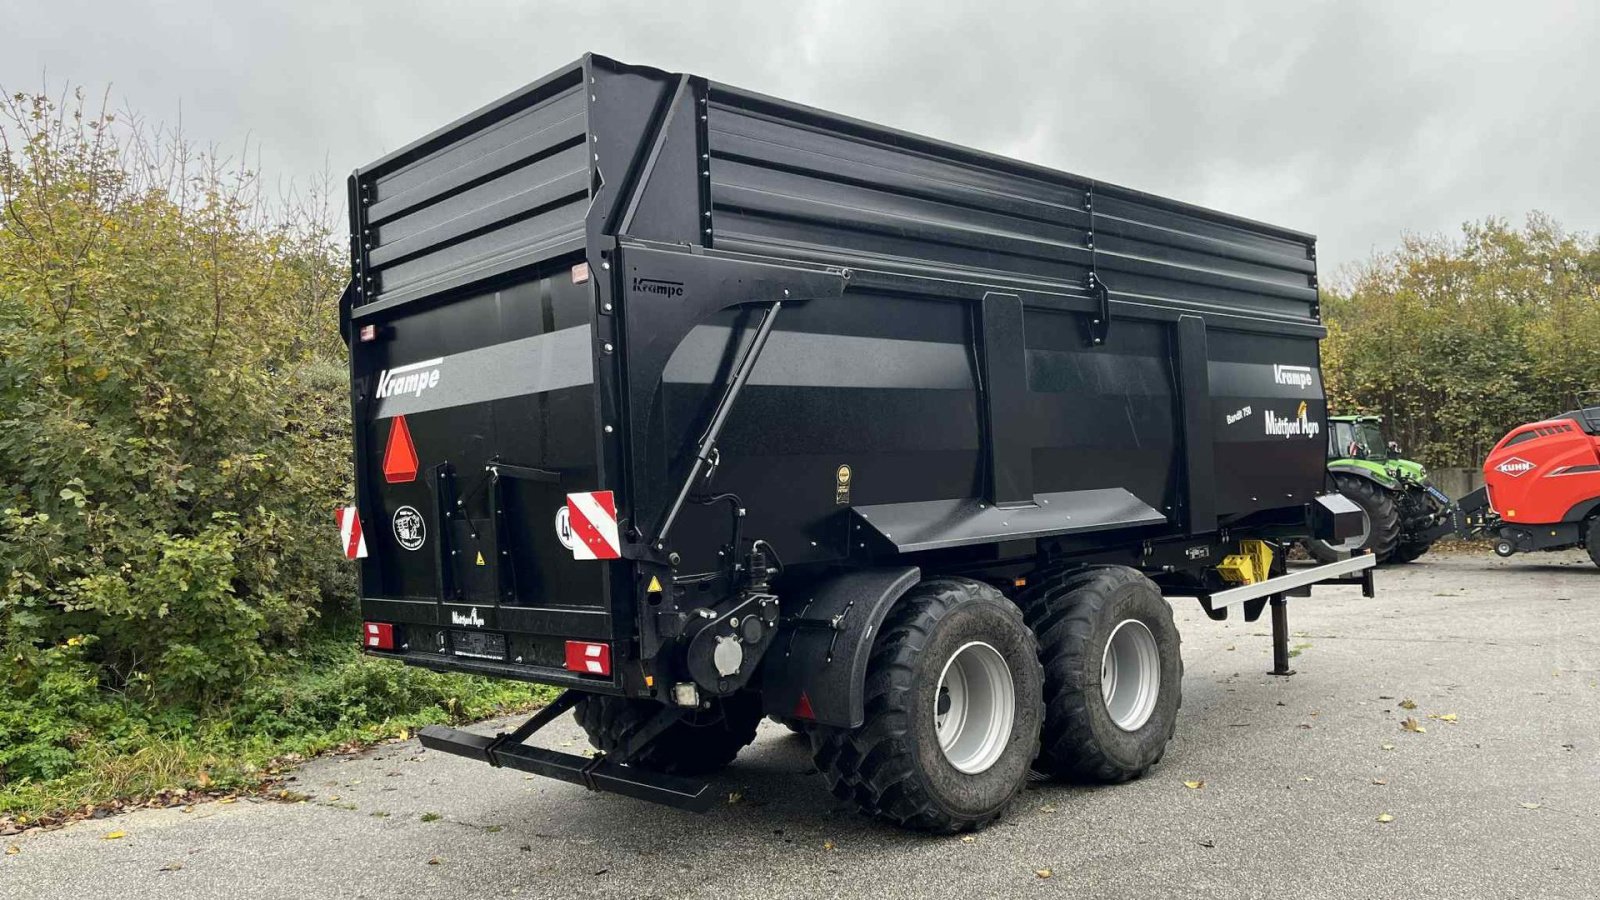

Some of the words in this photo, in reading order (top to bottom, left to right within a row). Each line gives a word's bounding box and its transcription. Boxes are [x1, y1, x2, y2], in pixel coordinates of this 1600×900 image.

[633, 277, 684, 298] Krampe
[376, 357, 443, 399] Krampe
[1273, 364, 1312, 389] Krampe
[1264, 410, 1300, 439] Midtfjord
[1301, 411, 1319, 438] Agro
[1500, 463, 1530, 472] KUHN
